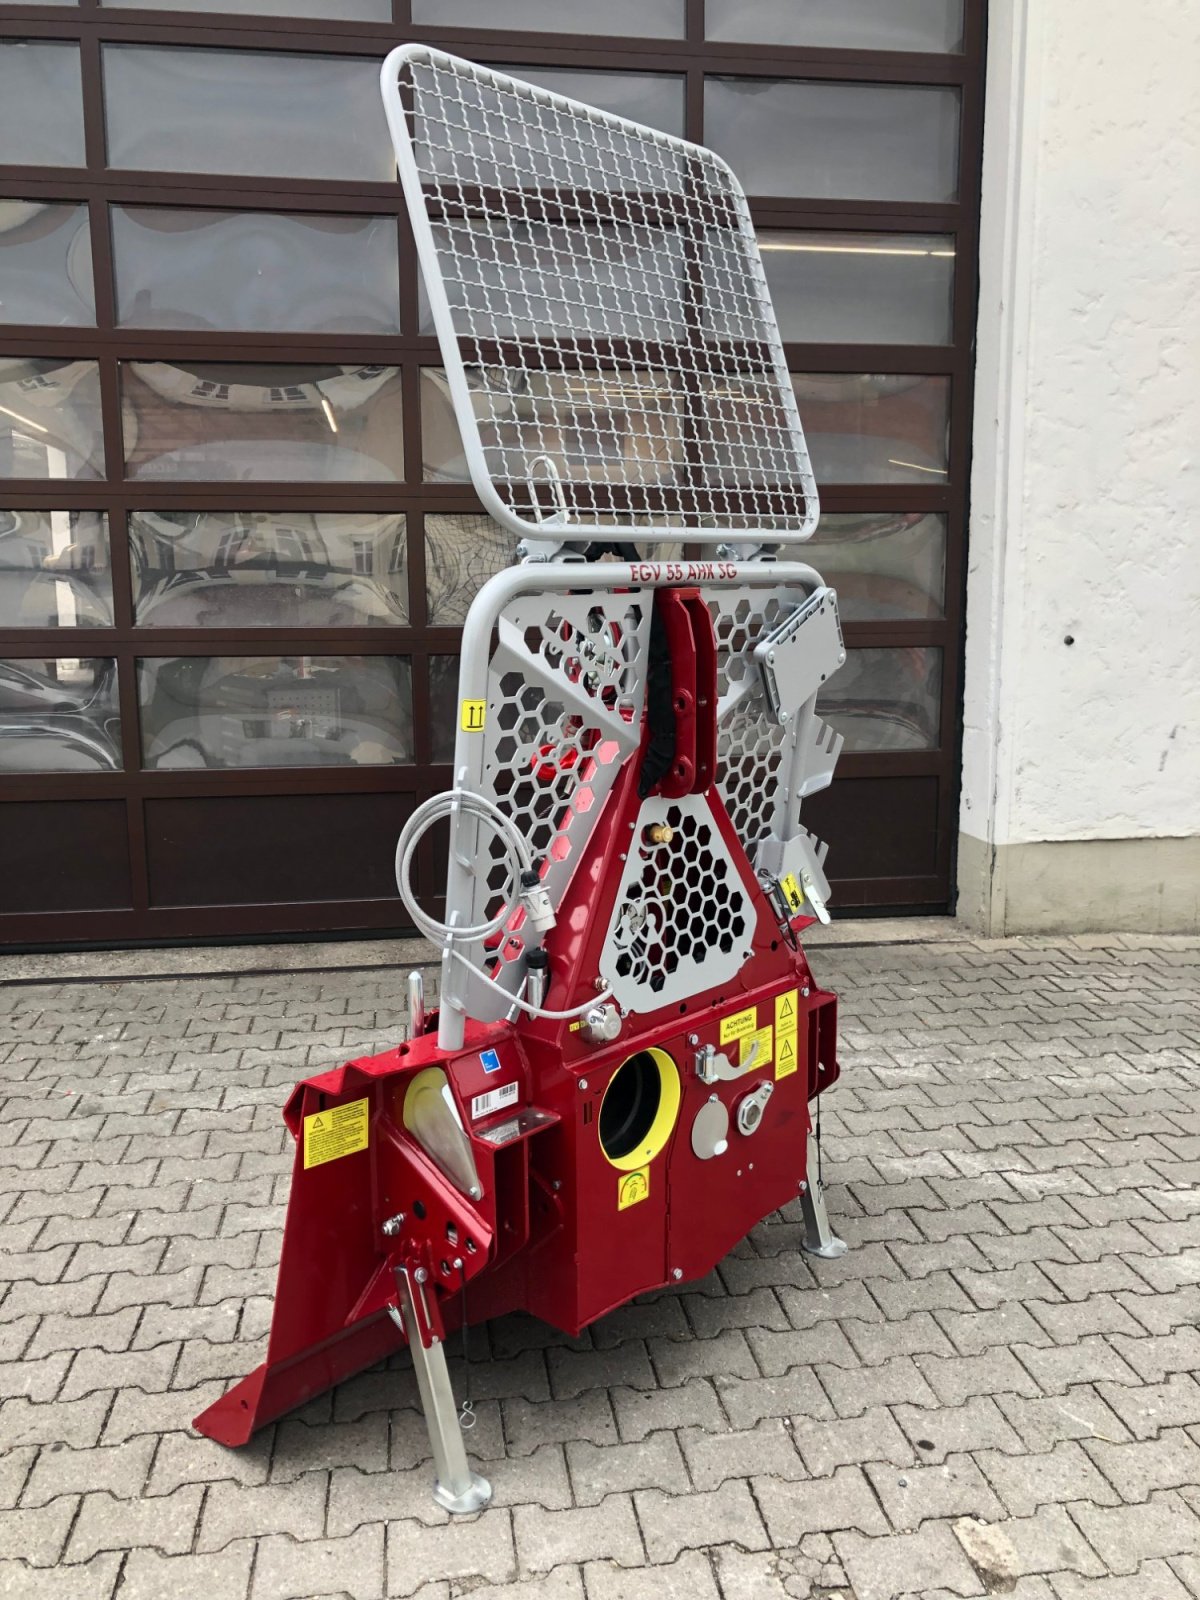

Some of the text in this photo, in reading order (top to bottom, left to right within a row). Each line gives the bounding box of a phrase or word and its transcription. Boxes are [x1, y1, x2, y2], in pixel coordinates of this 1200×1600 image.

[630, 563, 738, 581] EGV 55 AHK SG
[726, 1014, 752, 1029] ACHTUNG
